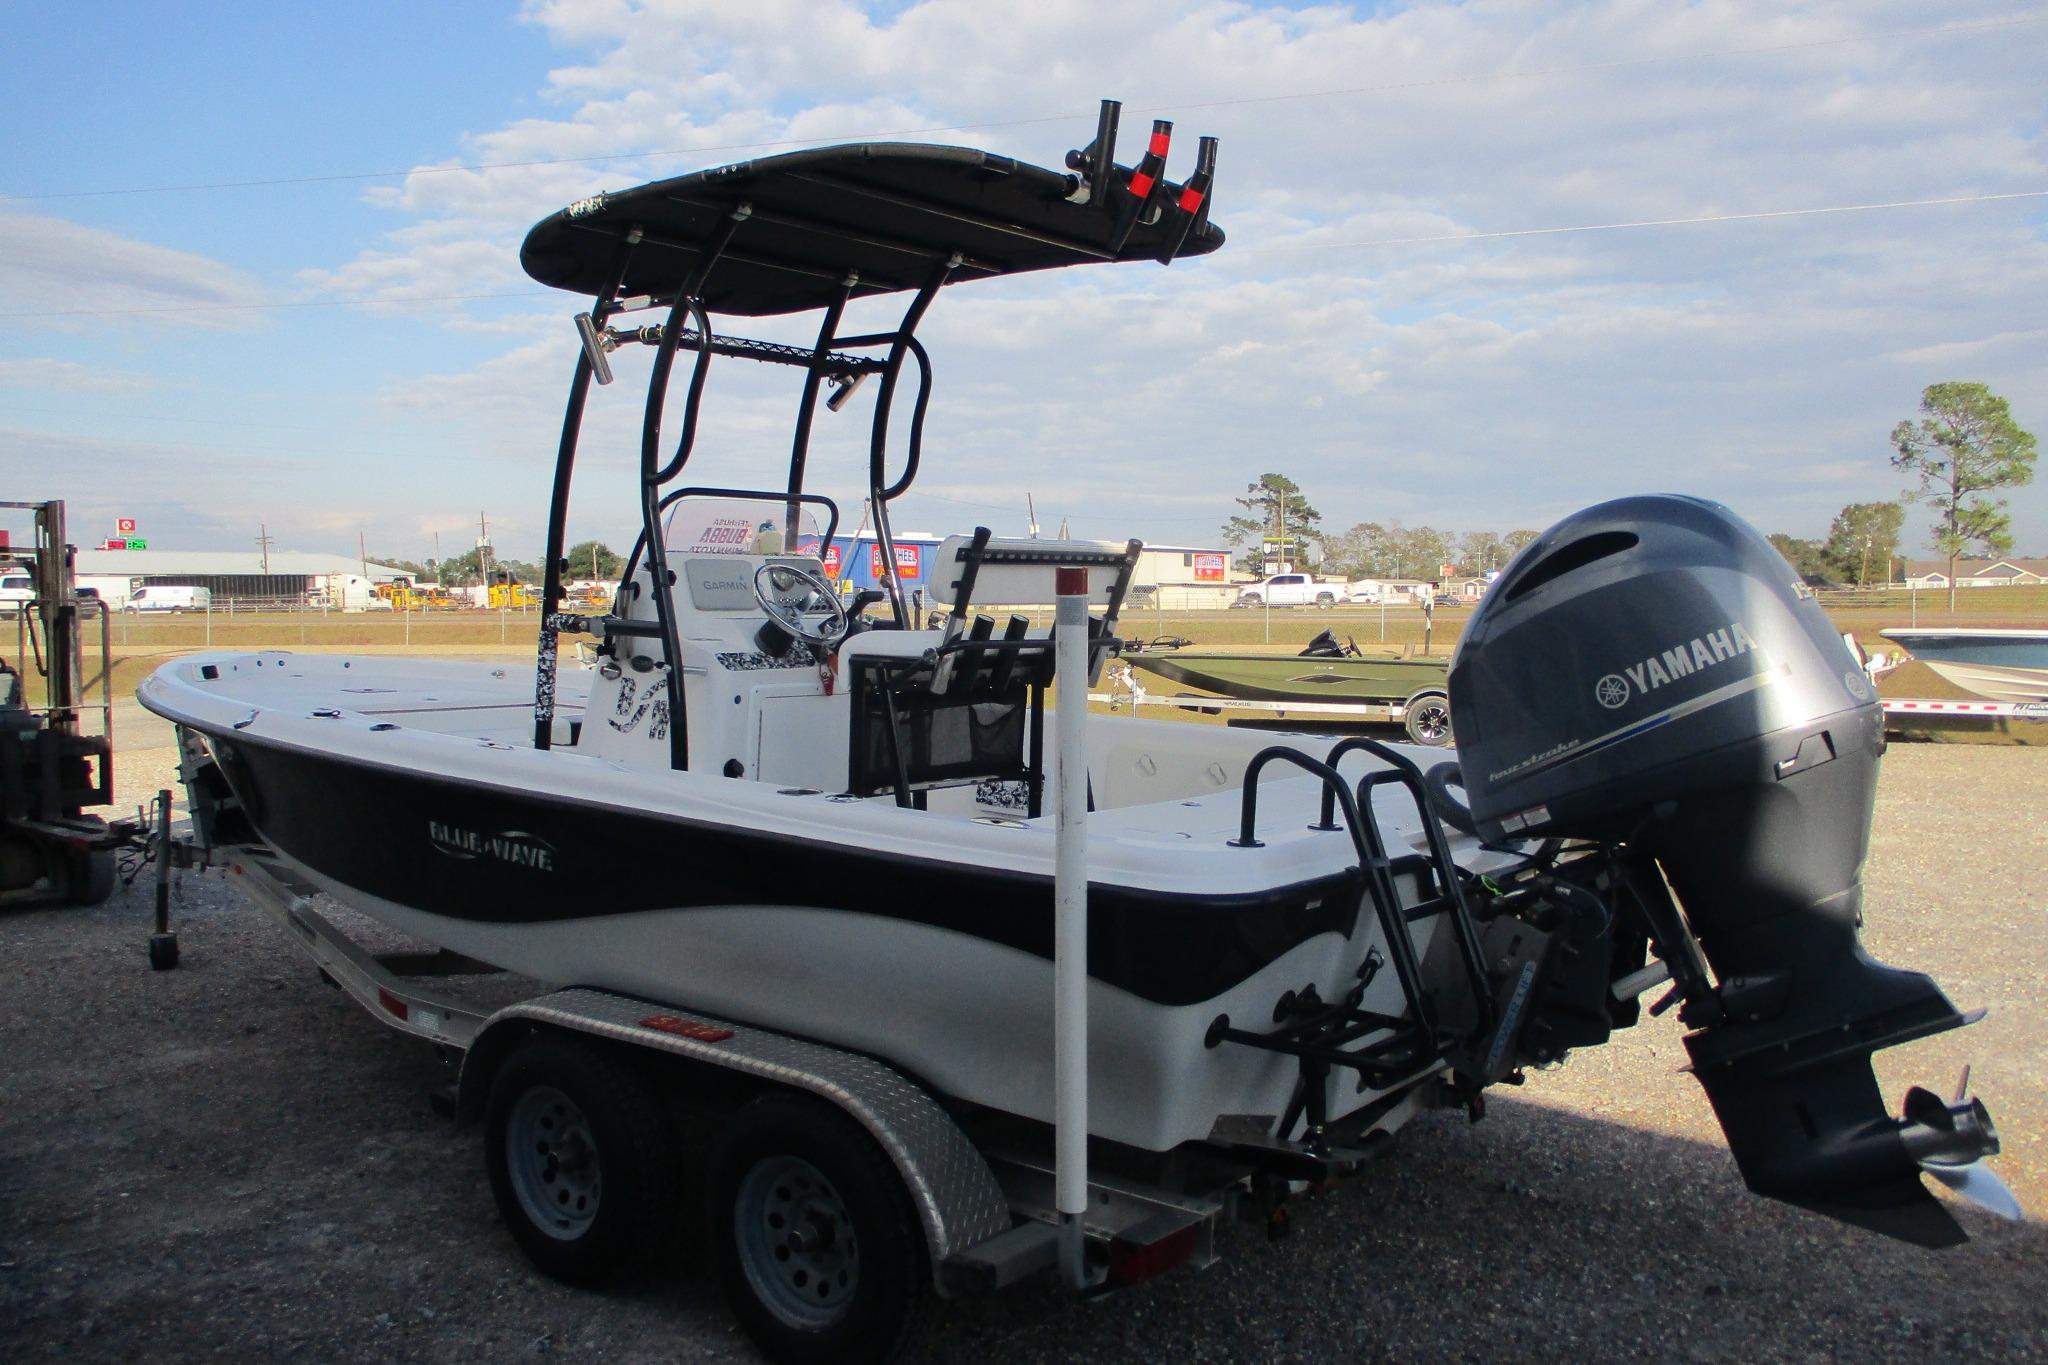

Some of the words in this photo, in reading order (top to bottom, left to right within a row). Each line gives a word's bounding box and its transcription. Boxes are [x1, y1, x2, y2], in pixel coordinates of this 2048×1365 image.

[703, 580, 748, 591] GARMIN
[1625, 622, 1758, 694] YAMAHA
[429, 820, 482, 853] BLUE
[492, 838, 553, 872] WAVE
